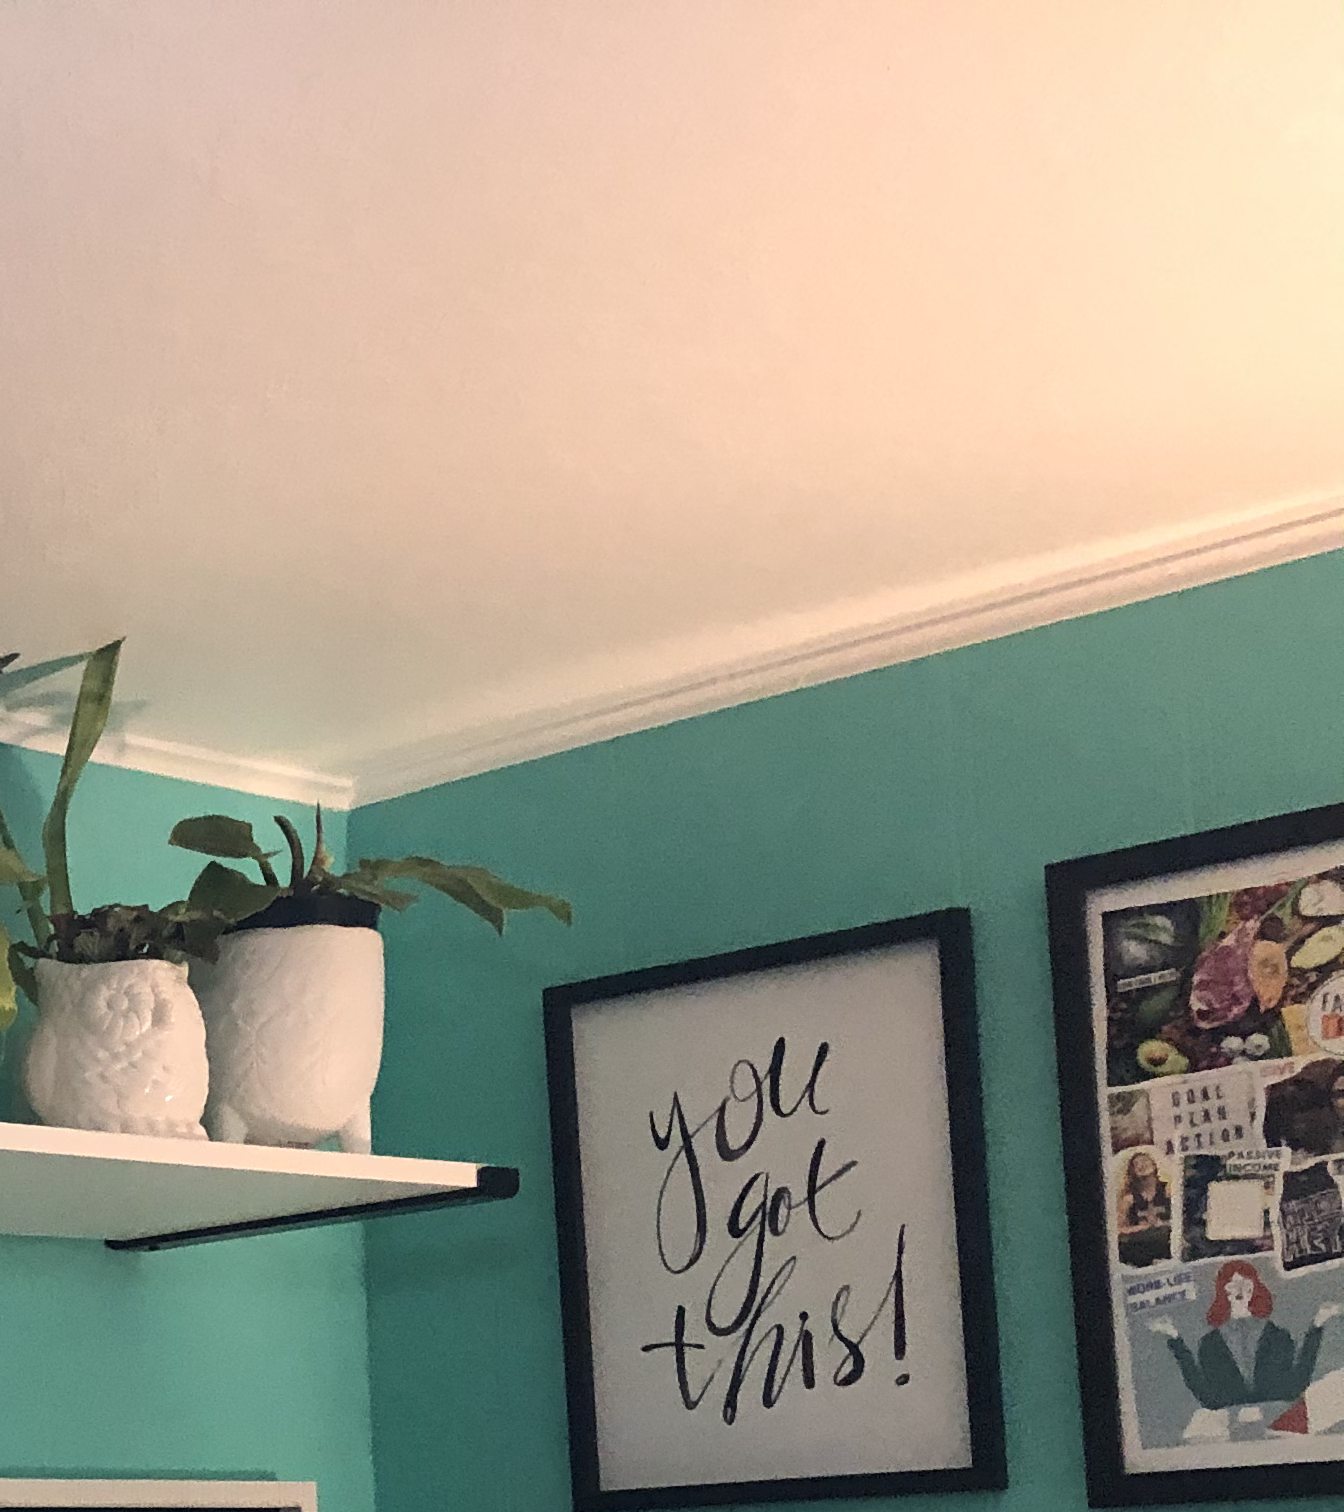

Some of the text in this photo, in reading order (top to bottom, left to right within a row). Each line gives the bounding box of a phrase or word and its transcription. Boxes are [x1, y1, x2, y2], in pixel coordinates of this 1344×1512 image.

[648, 1036, 831, 1275] you
[1165, 1124, 1244, 1155] ACTION
[1173, 1105, 1227, 1129] PLAN
[642, 1224, 911, 1426] this!
[705, 1138, 862, 1337] got
